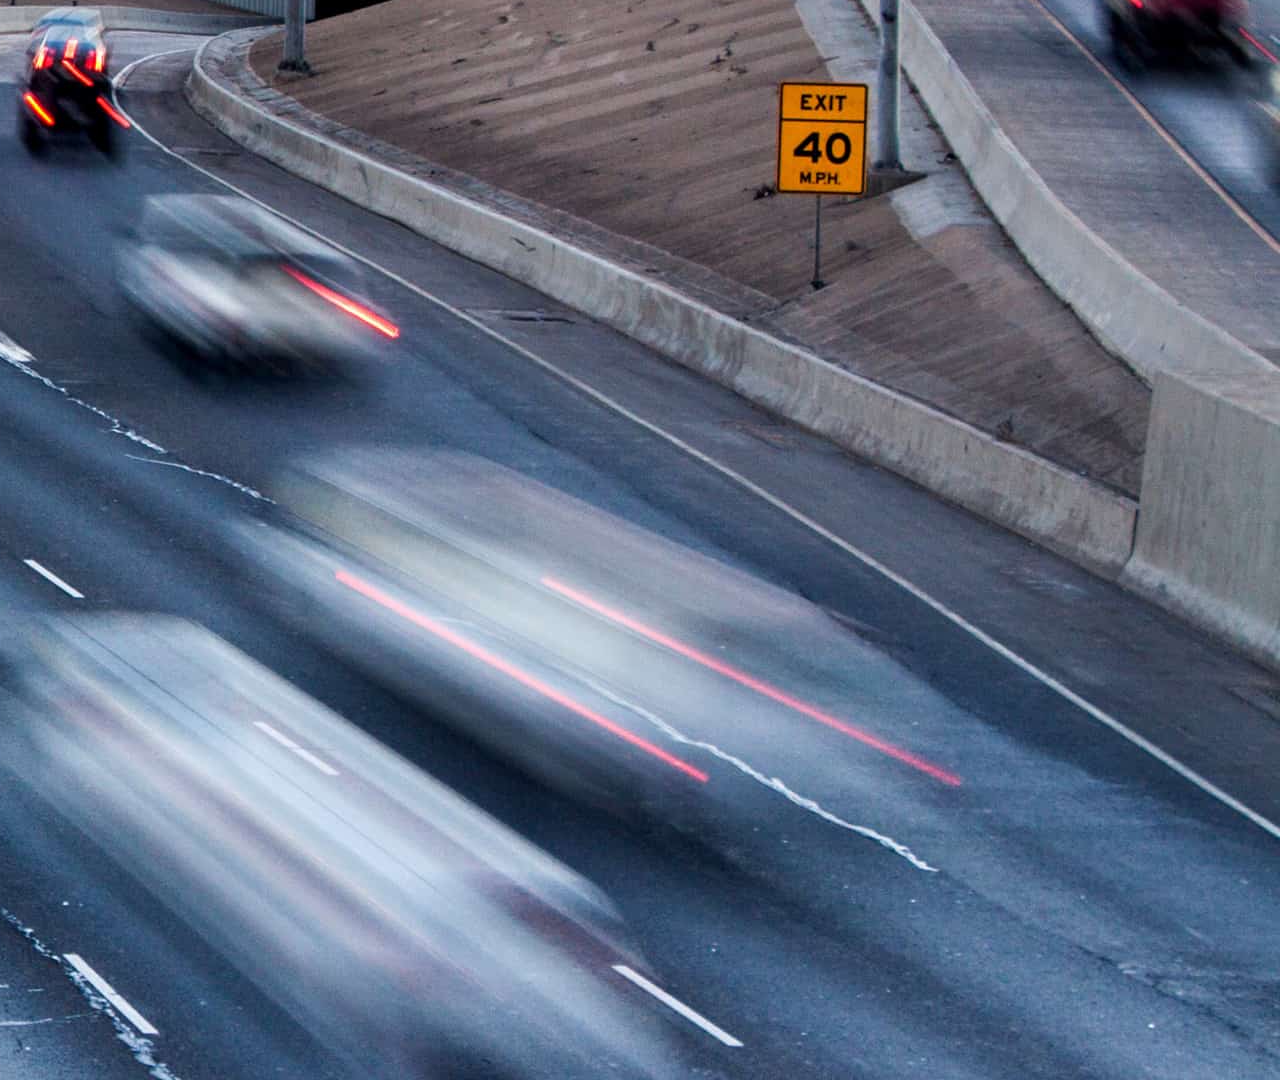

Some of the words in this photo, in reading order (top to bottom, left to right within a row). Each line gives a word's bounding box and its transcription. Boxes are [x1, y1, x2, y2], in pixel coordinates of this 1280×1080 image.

[801, 95, 846, 111] EXIT
[794, 132, 852, 164] 40
[800, 172, 840, 185] M.P.H.
